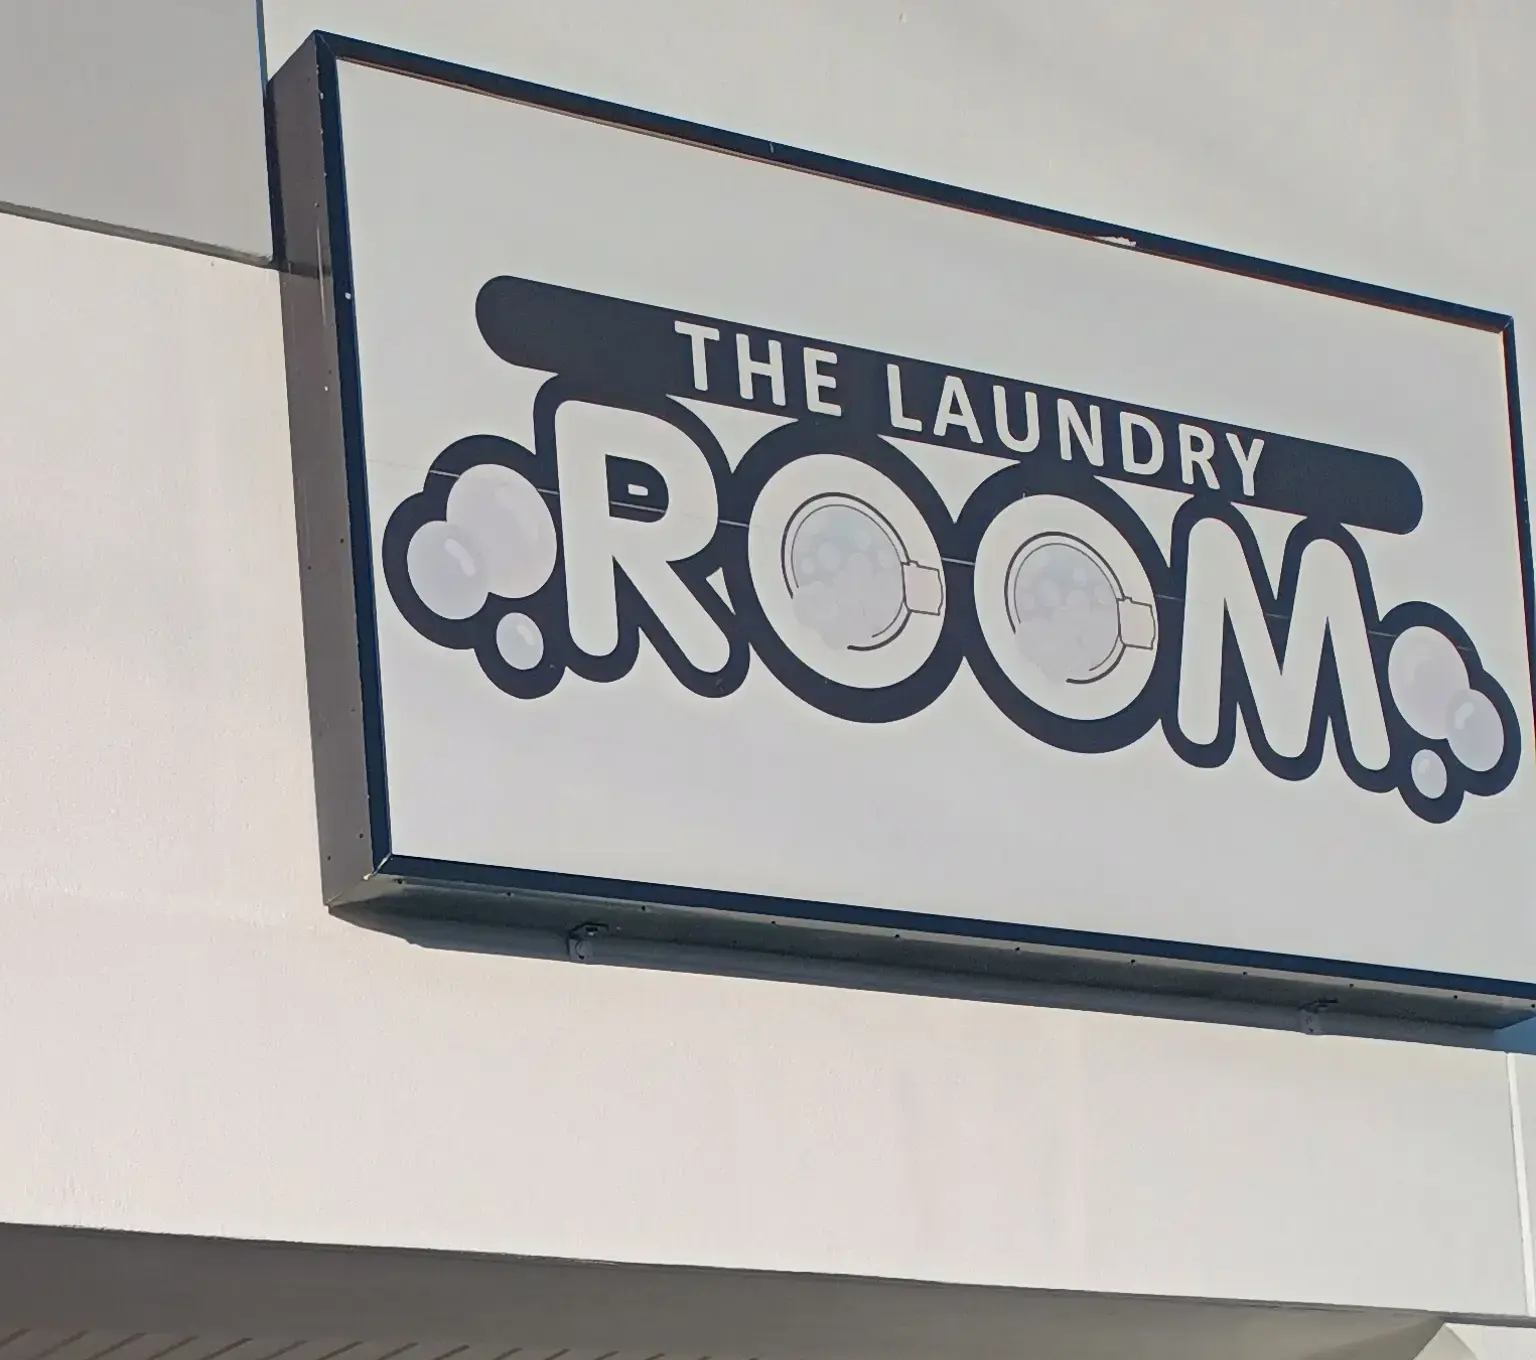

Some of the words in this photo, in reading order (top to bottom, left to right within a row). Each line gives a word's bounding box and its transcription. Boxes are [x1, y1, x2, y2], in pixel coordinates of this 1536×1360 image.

[675, 318, 842, 416] THE
[885, 363, 1267, 499] LAUNDRY
[554, 398, 1392, 774] ROOM
